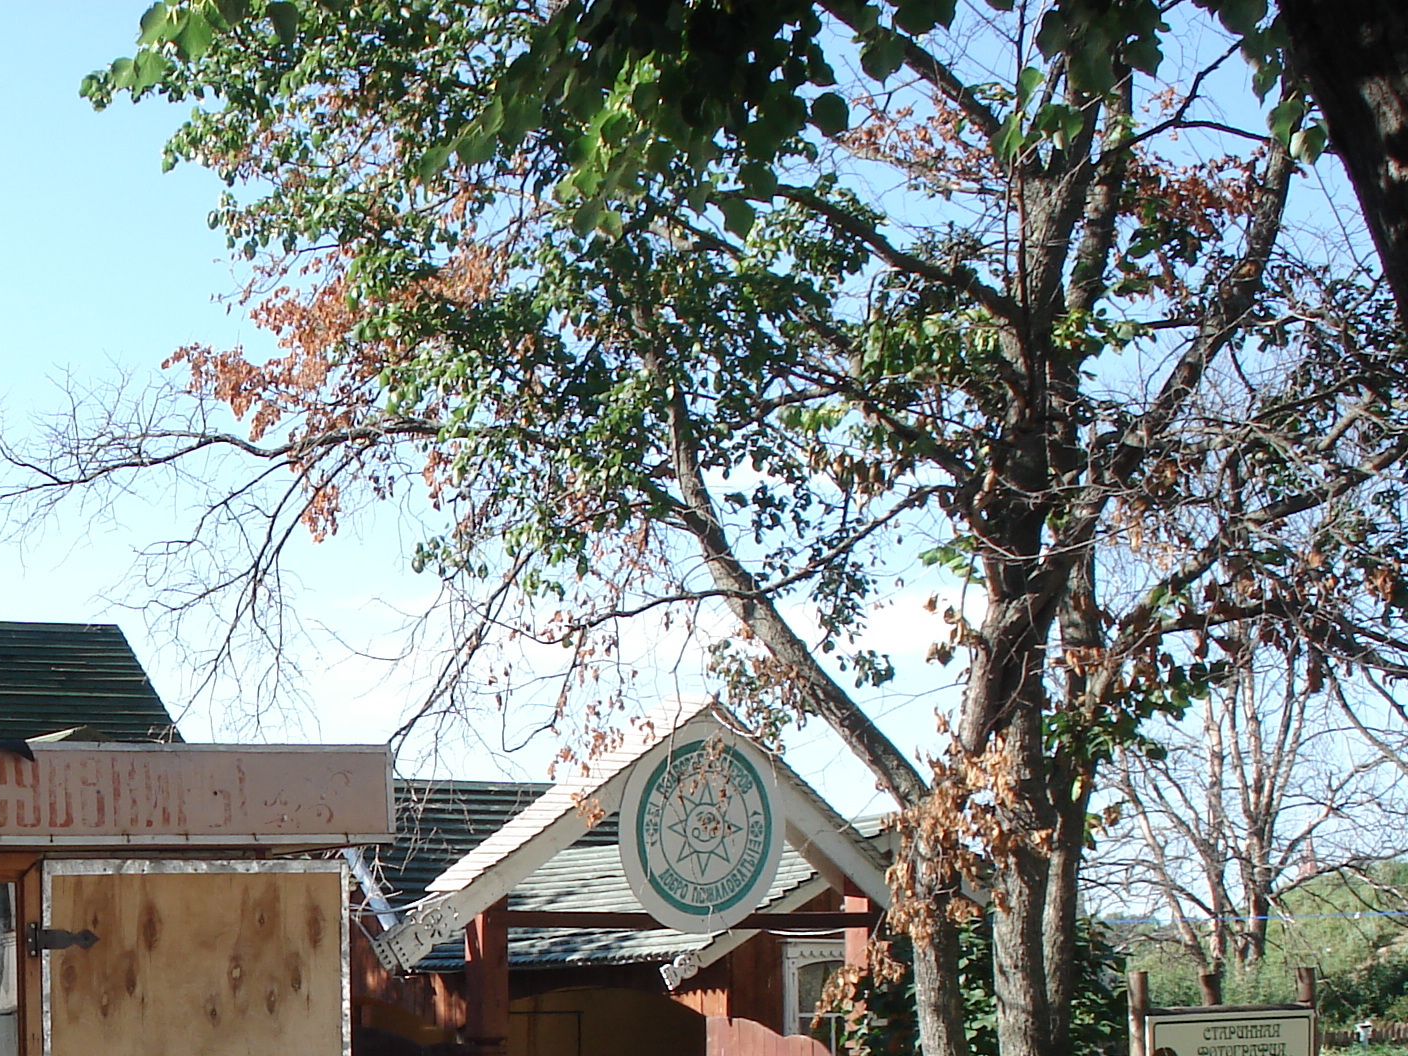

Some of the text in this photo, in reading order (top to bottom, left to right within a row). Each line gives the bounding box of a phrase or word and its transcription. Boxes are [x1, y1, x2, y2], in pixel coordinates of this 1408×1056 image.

[706, 754, 753, 794] СТЕРОВ
[658, 867, 689, 900] ДОБРО
[1203, 1024, 1281, 1041] СТАРИННАЯ
